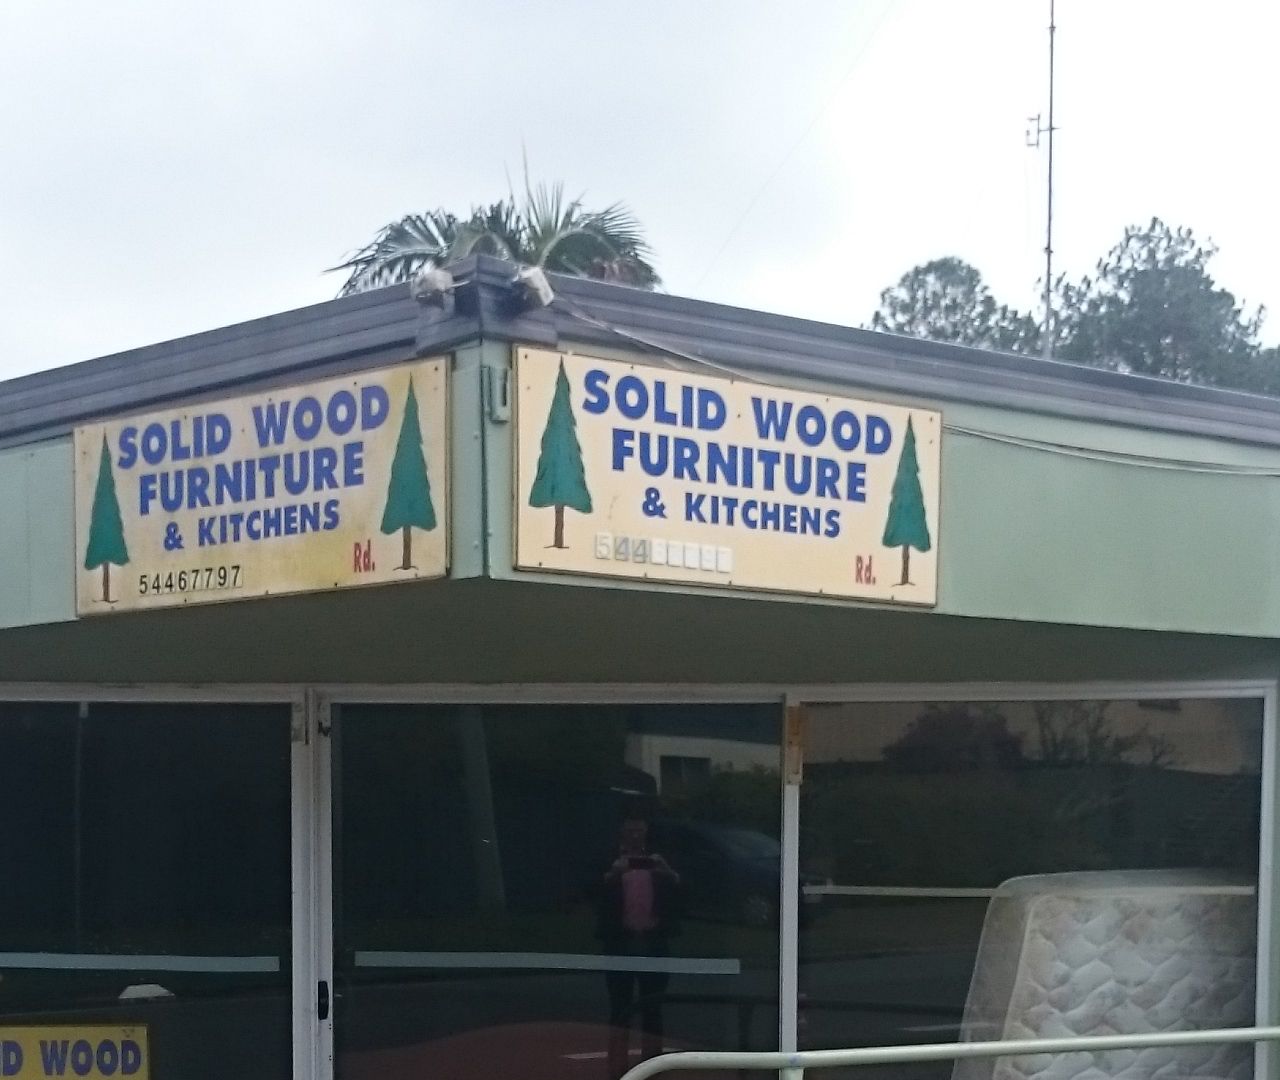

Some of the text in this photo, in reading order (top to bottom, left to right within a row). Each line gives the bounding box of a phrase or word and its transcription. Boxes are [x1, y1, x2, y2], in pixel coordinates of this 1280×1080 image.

[118, 385, 390, 470] SOLID WOOD
[582, 369, 892, 455] SOLID WOOD
[139, 441, 365, 516] FURNITURE
[612, 428, 867, 503] FURNITURE
[163, 500, 340, 552] & KITCHENS
[642, 487, 840, 538] & KITCHENS
[138, 565, 242, 595] 54467797
[39, 1038, 142, 1077] WOOD
